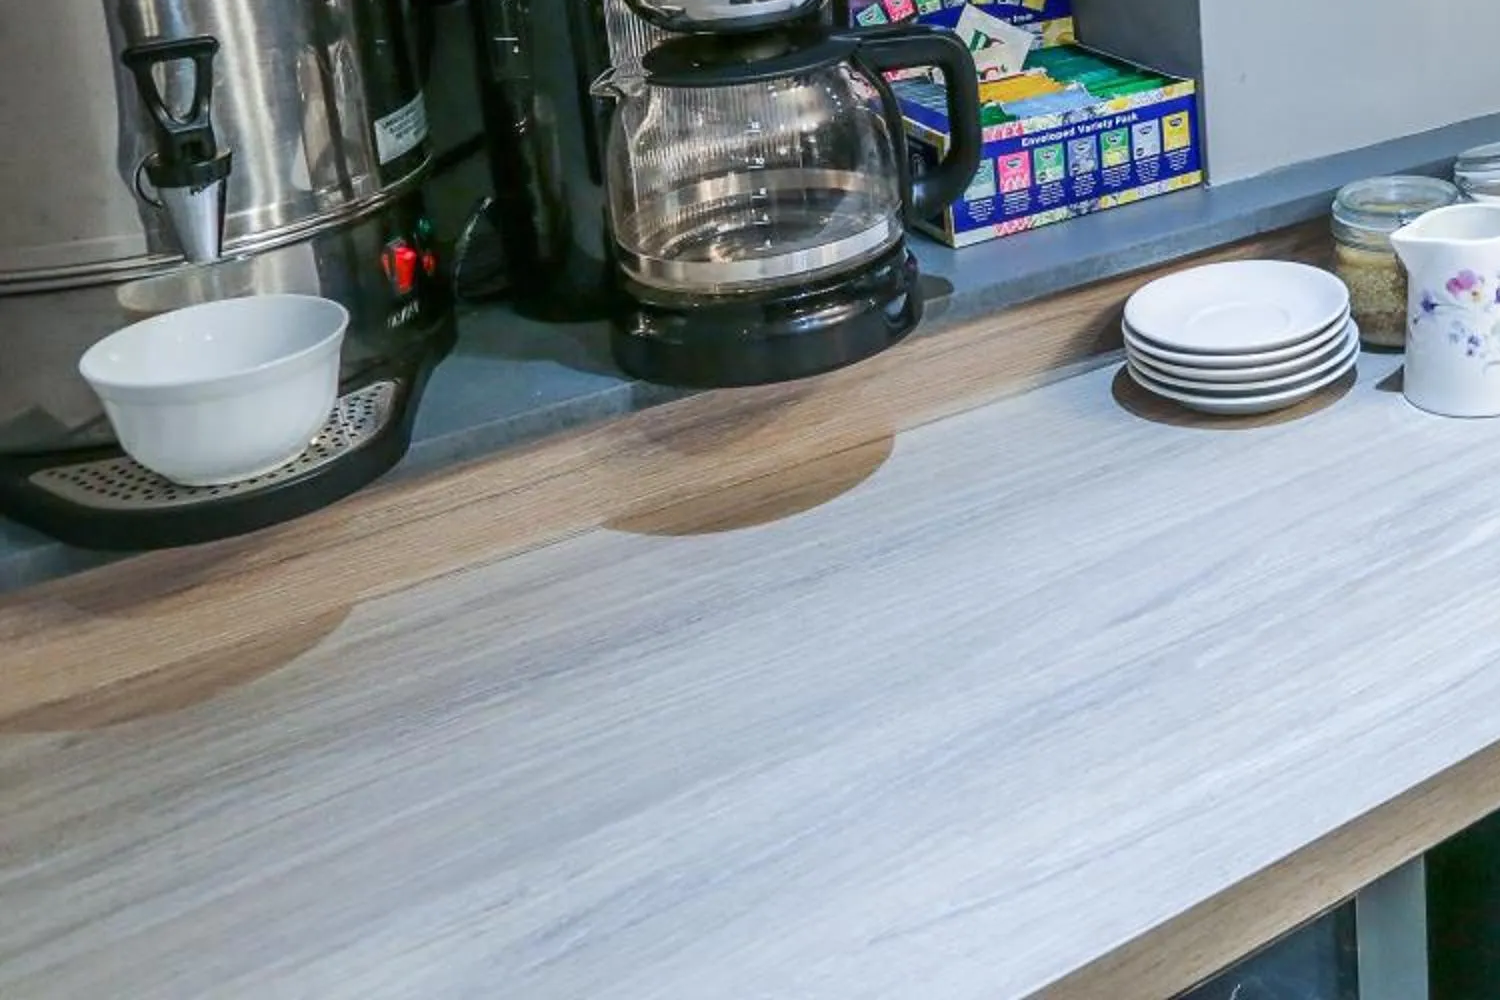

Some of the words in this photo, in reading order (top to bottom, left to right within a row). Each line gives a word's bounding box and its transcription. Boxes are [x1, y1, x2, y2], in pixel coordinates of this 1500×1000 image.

[1021, 127, 1075, 147] Enveloped
[1077, 119, 1114, 135] Variety
[1115, 111, 1138, 125] Pack
